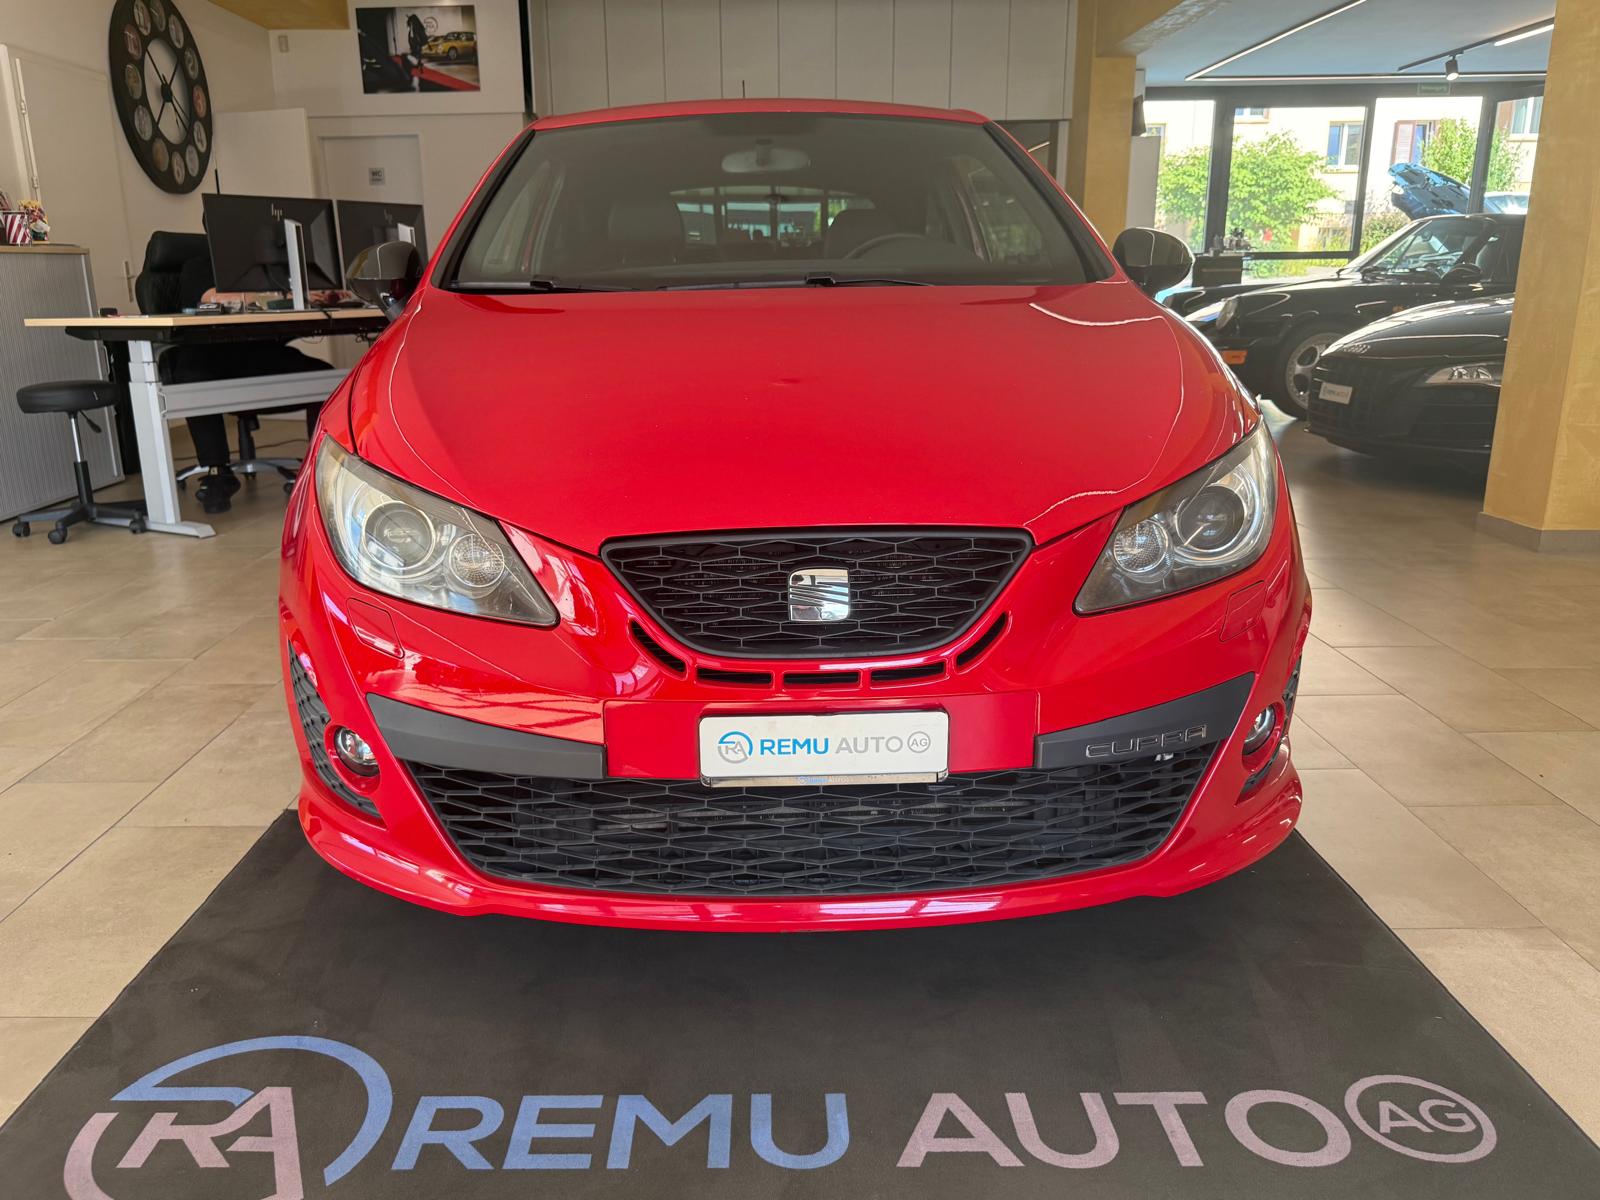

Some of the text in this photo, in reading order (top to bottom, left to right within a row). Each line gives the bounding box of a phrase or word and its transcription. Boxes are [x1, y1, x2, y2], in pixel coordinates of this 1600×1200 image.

[760, 738, 829, 755] REMU
[835, 736, 903, 753] AUTO
[1086, 725, 1206, 757] CUPRA
[391, 1093, 850, 1169] REMU
[896, 1089, 1352, 1169] AUTO
[1379, 1099, 1477, 1134] AG
